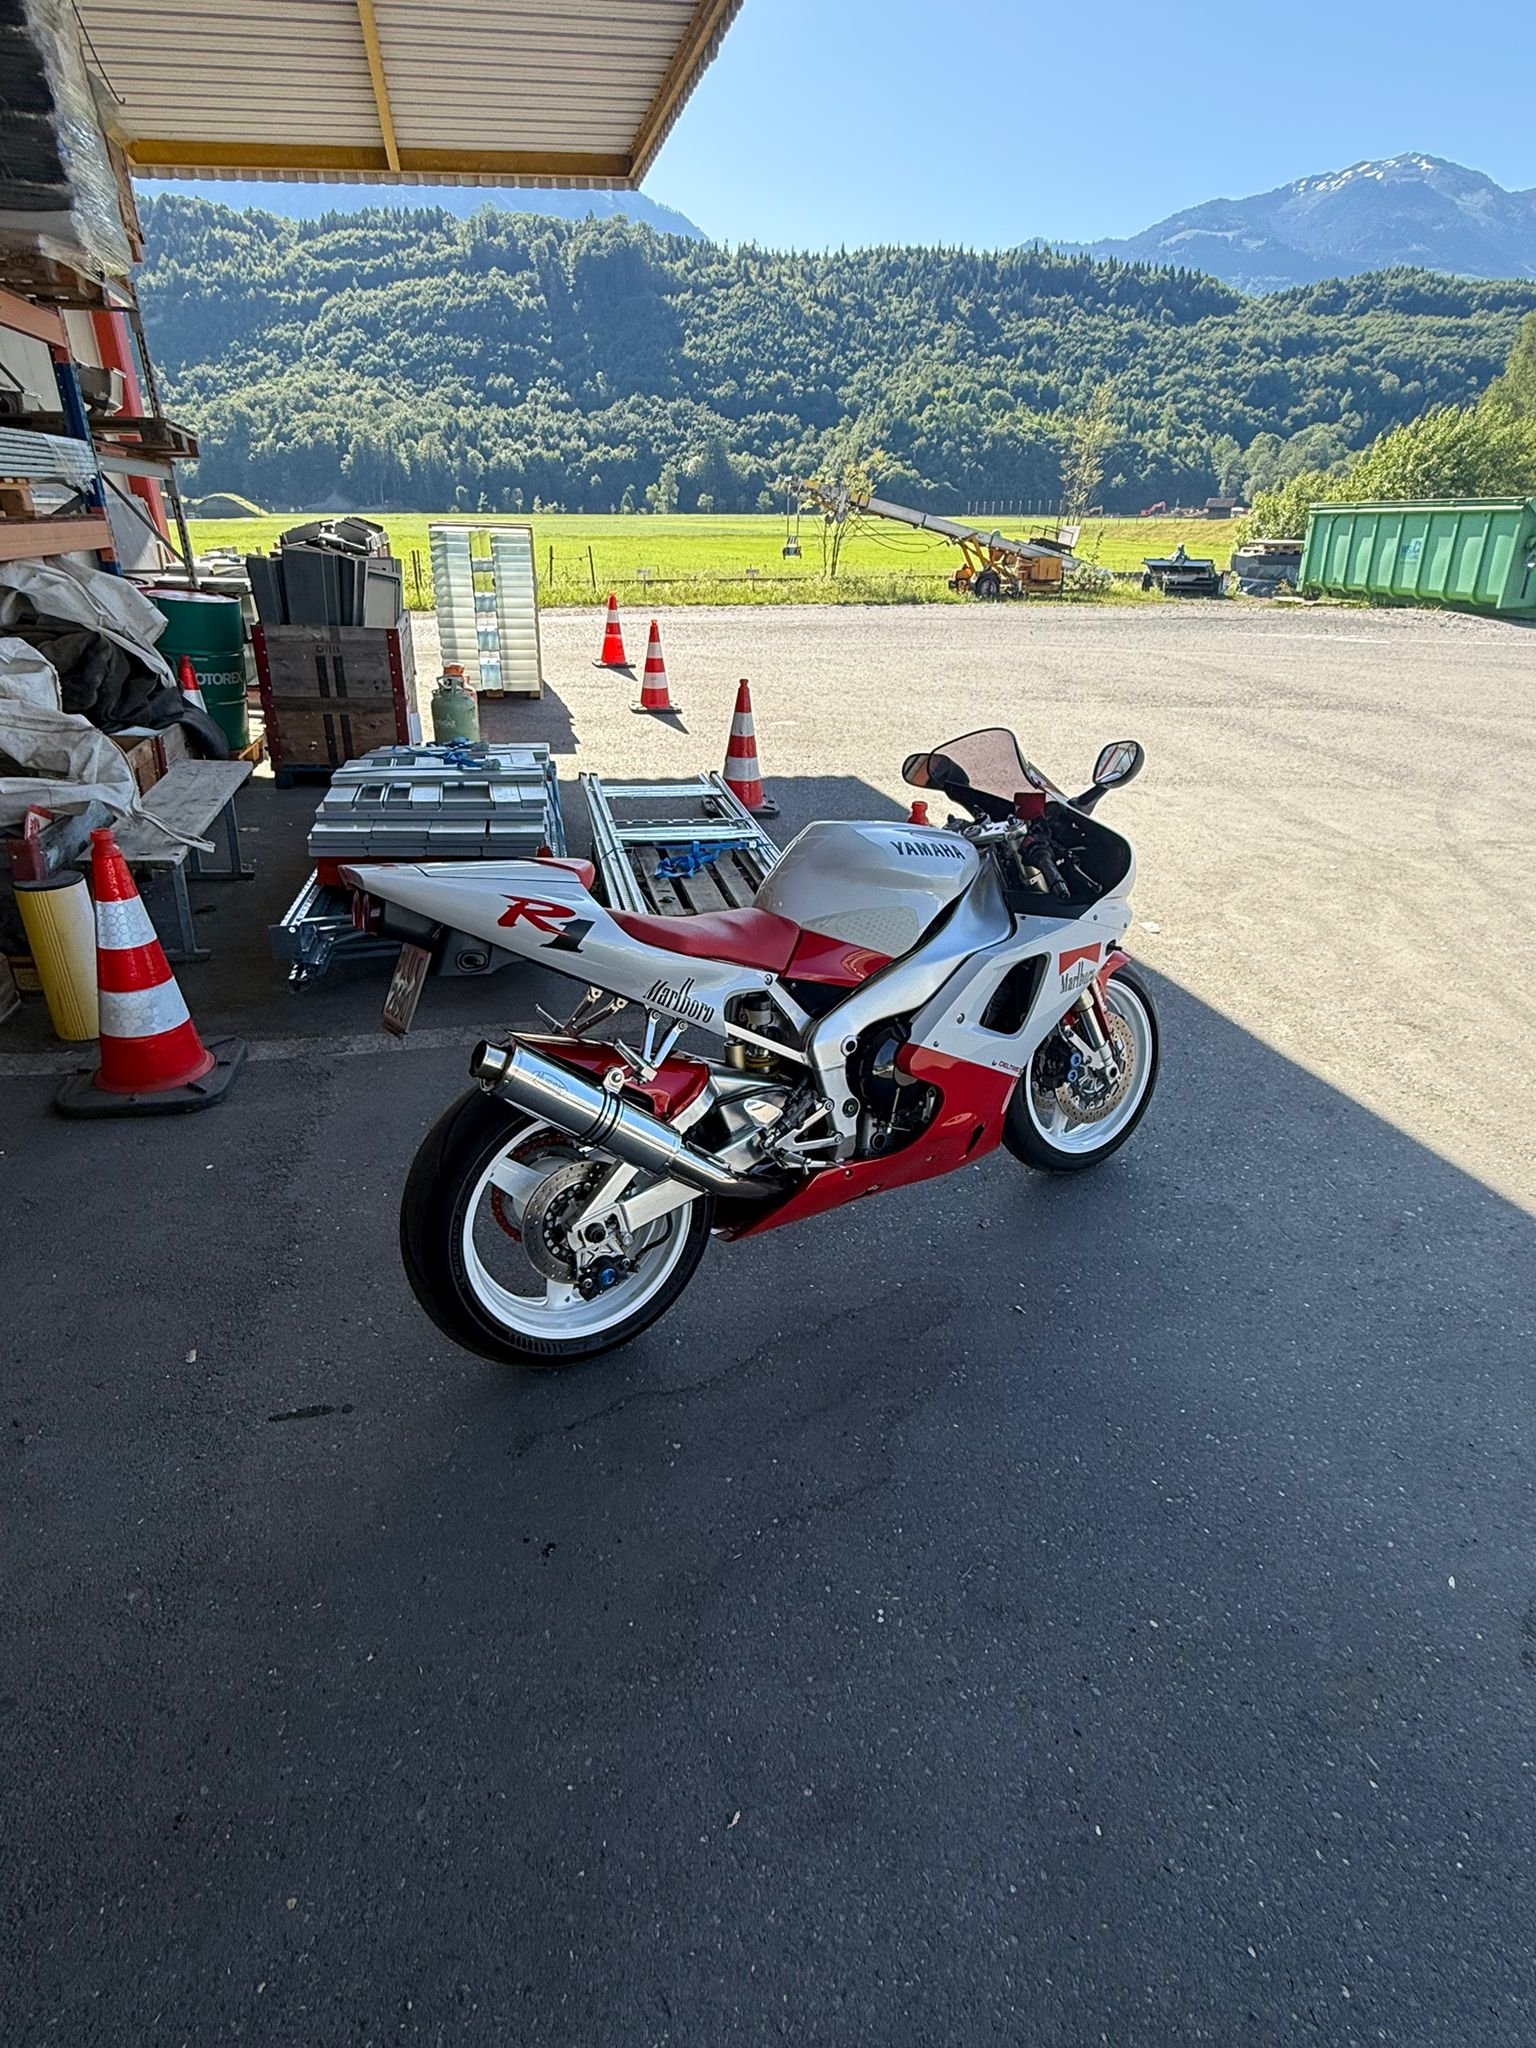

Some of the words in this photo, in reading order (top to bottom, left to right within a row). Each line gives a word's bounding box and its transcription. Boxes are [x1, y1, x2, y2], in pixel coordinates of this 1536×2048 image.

[889, 841, 966, 860] YAMAHA
[497, 893, 597, 954] R1
[642, 977, 715, 1023] Marlboro
